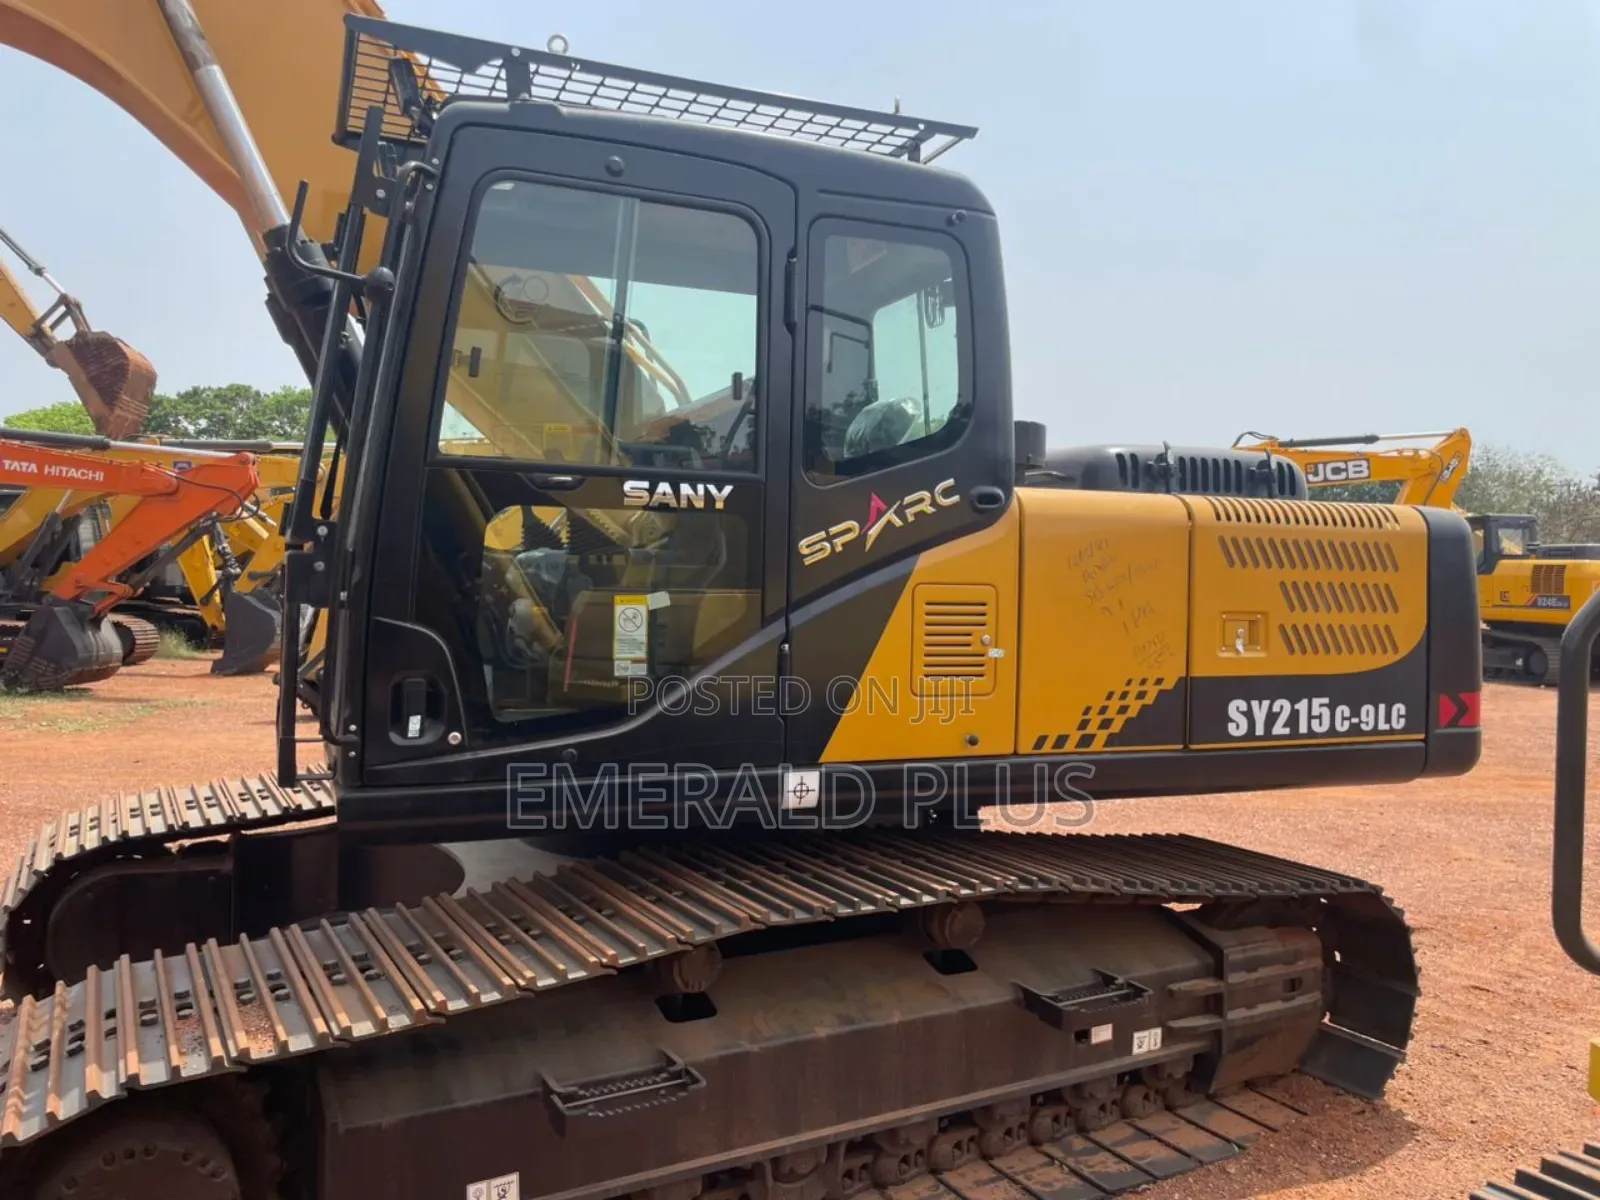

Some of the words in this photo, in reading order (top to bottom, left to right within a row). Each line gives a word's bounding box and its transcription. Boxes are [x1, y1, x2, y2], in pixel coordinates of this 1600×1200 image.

[3, 459, 38, 474] TATA
[44, 464, 105, 482] HITACHI
[1307, 459, 1370, 482] JCB
[623, 480, 734, 510] SANY
[798, 477, 961, 566] SPARC
